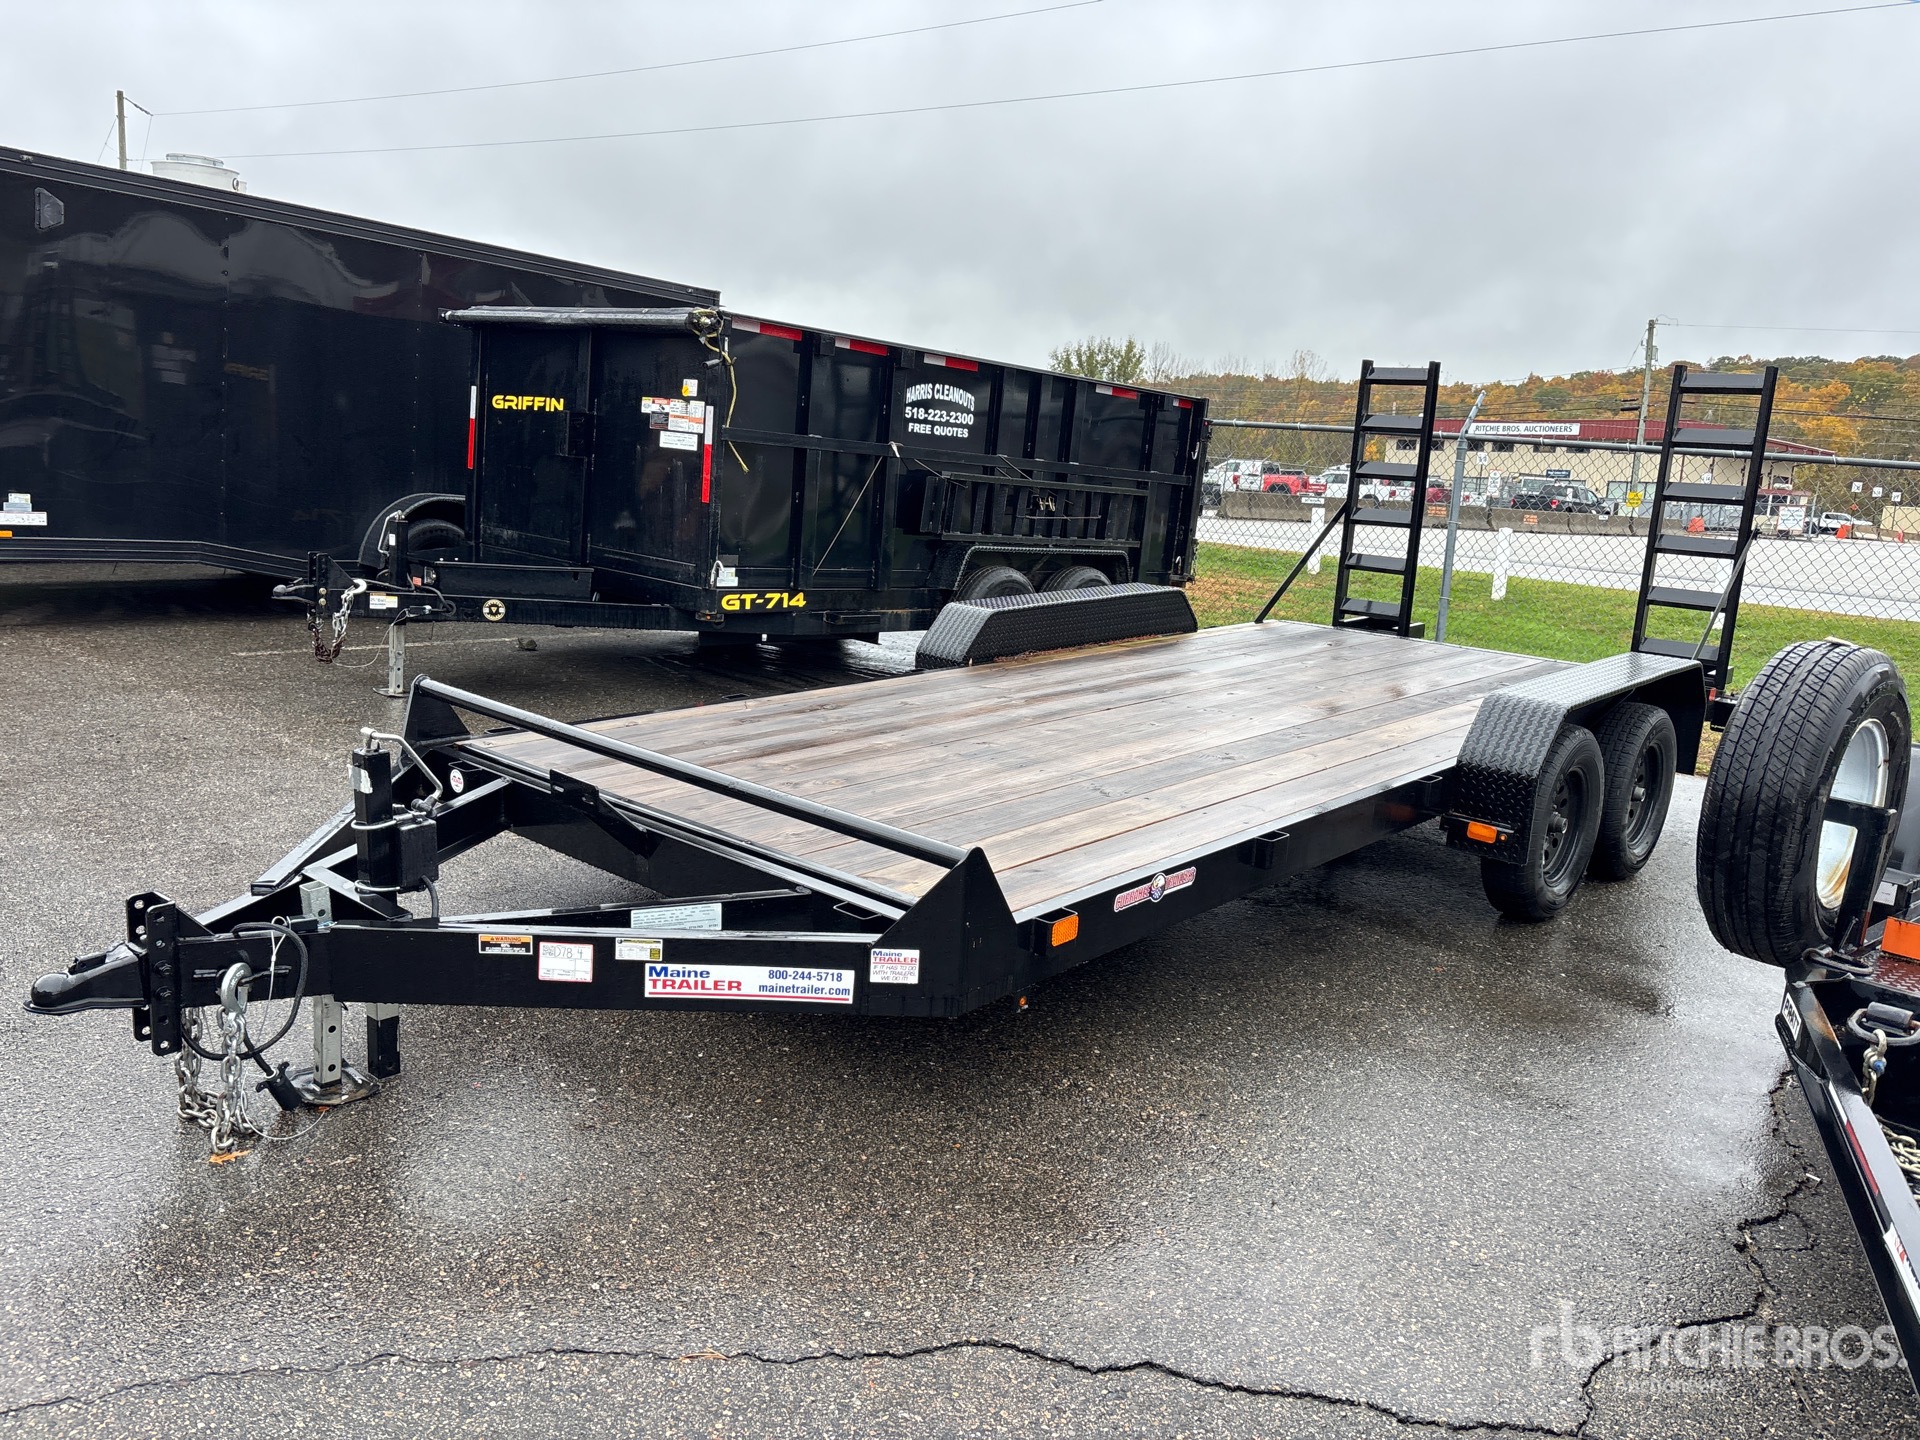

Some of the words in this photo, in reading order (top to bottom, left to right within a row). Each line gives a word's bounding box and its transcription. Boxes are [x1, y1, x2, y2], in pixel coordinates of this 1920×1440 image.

[492, 395, 564, 411] GRIFFIN
[906, 383, 932, 404] HARRIS
[934, 383, 975, 411] CLEANOUTS
[905, 406, 974, 425] 518-223-2300
[908, 422, 932, 434] FREE
[933, 425, 969, 438] QUOTES
[1475, 425, 1500, 433] RITCHIE
[1523, 425, 1573, 433] AUCTIONEERS
[721, 592, 807, 611] GT-714
[648, 966, 711, 979] Maine
[768, 969, 843, 982] 800-244-5718
[648, 979, 742, 991] TRAILER
[758, 983, 850, 996] mainetrailer.com
[1784, 997, 1799, 1034] PRATT
